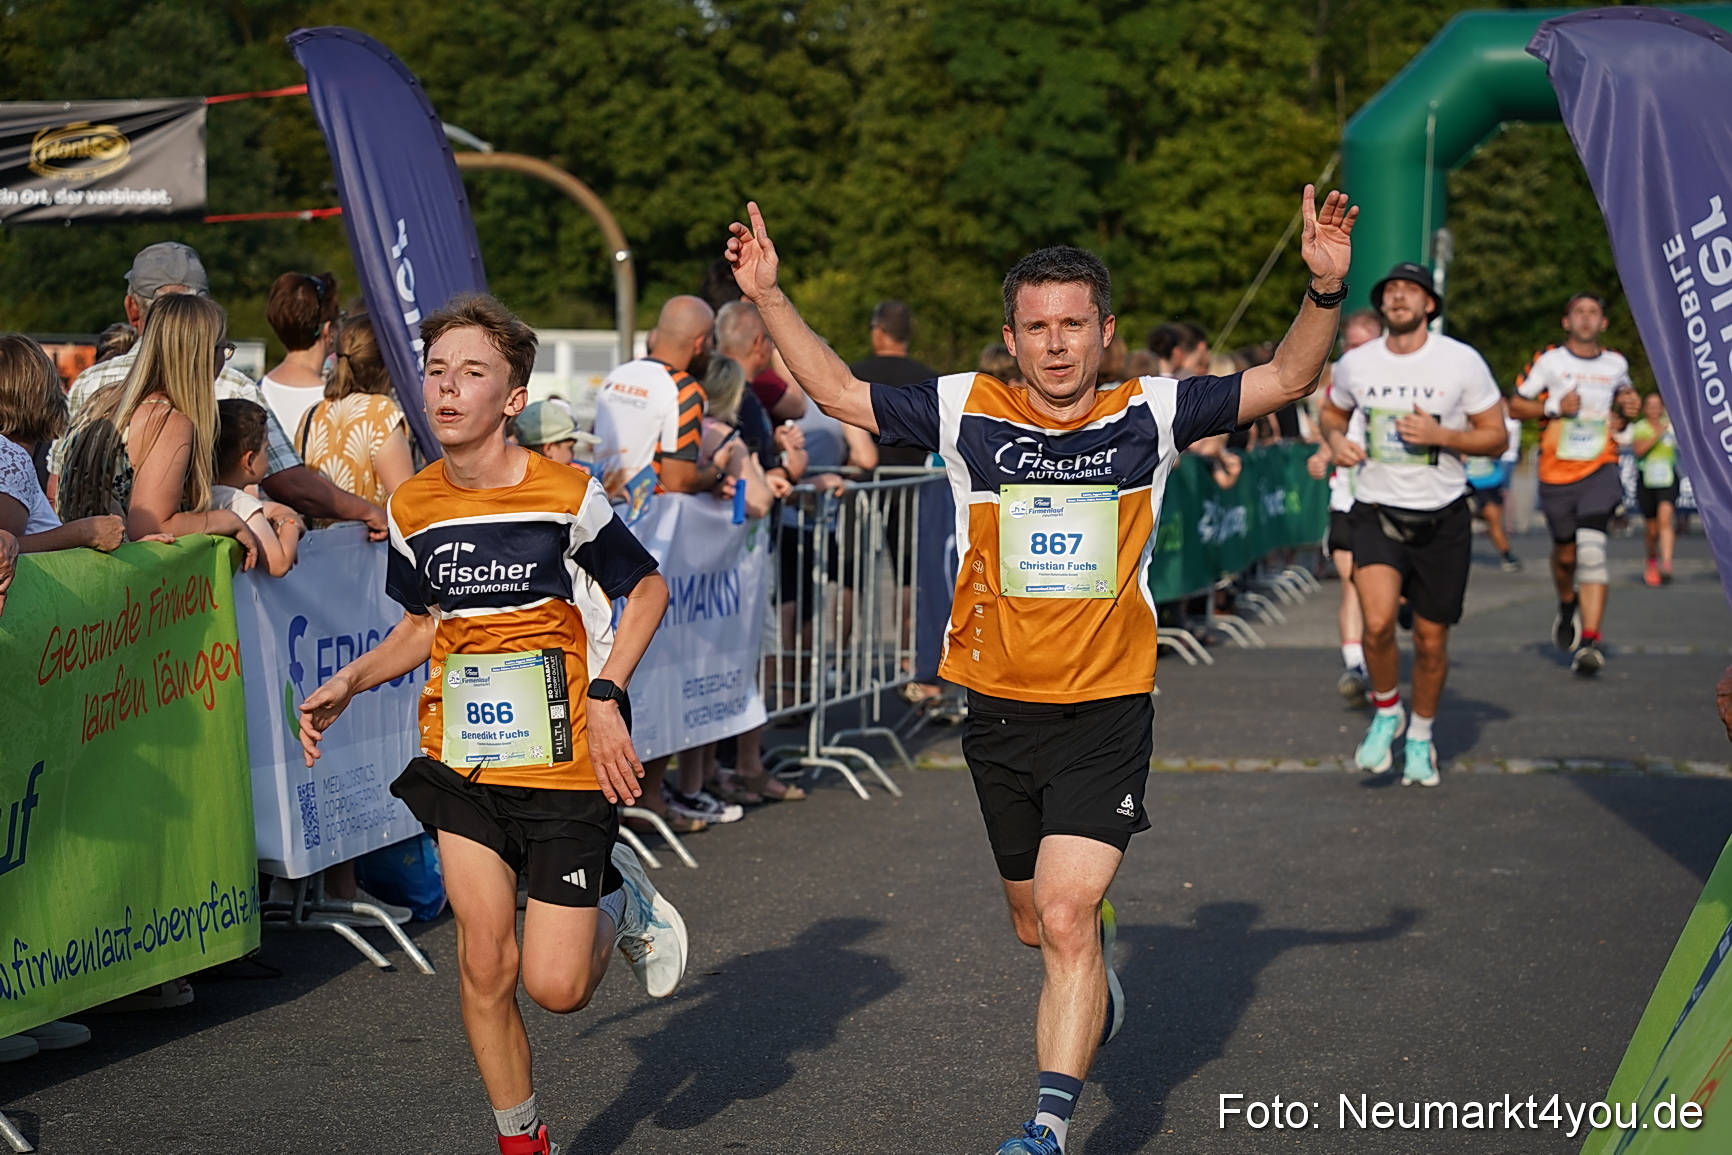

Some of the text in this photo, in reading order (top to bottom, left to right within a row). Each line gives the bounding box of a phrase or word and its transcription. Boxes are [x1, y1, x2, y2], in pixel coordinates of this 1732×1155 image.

[20, 188, 52, 207] Ort,
[54, 187, 84, 205] der
[85, 187, 172, 206] verbindet.
[1017, 447, 1118, 471] Fischer
[1025, 467, 1113, 480] AUTOMOBILE
[1030, 532, 1083, 555] 867
[438, 559, 538, 584] Fischer
[1019, 561, 1098, 571] Christian Fuchs
[447, 582, 530, 596] AUTOMOBILE
[148, 575, 219, 637] Firmen
[81, 640, 242, 745] laufen länger
[466, 701, 514, 724] 866
[461, 729, 530, 740] Benedikt Fuchs
[554, 721, 564, 755] HILTL
